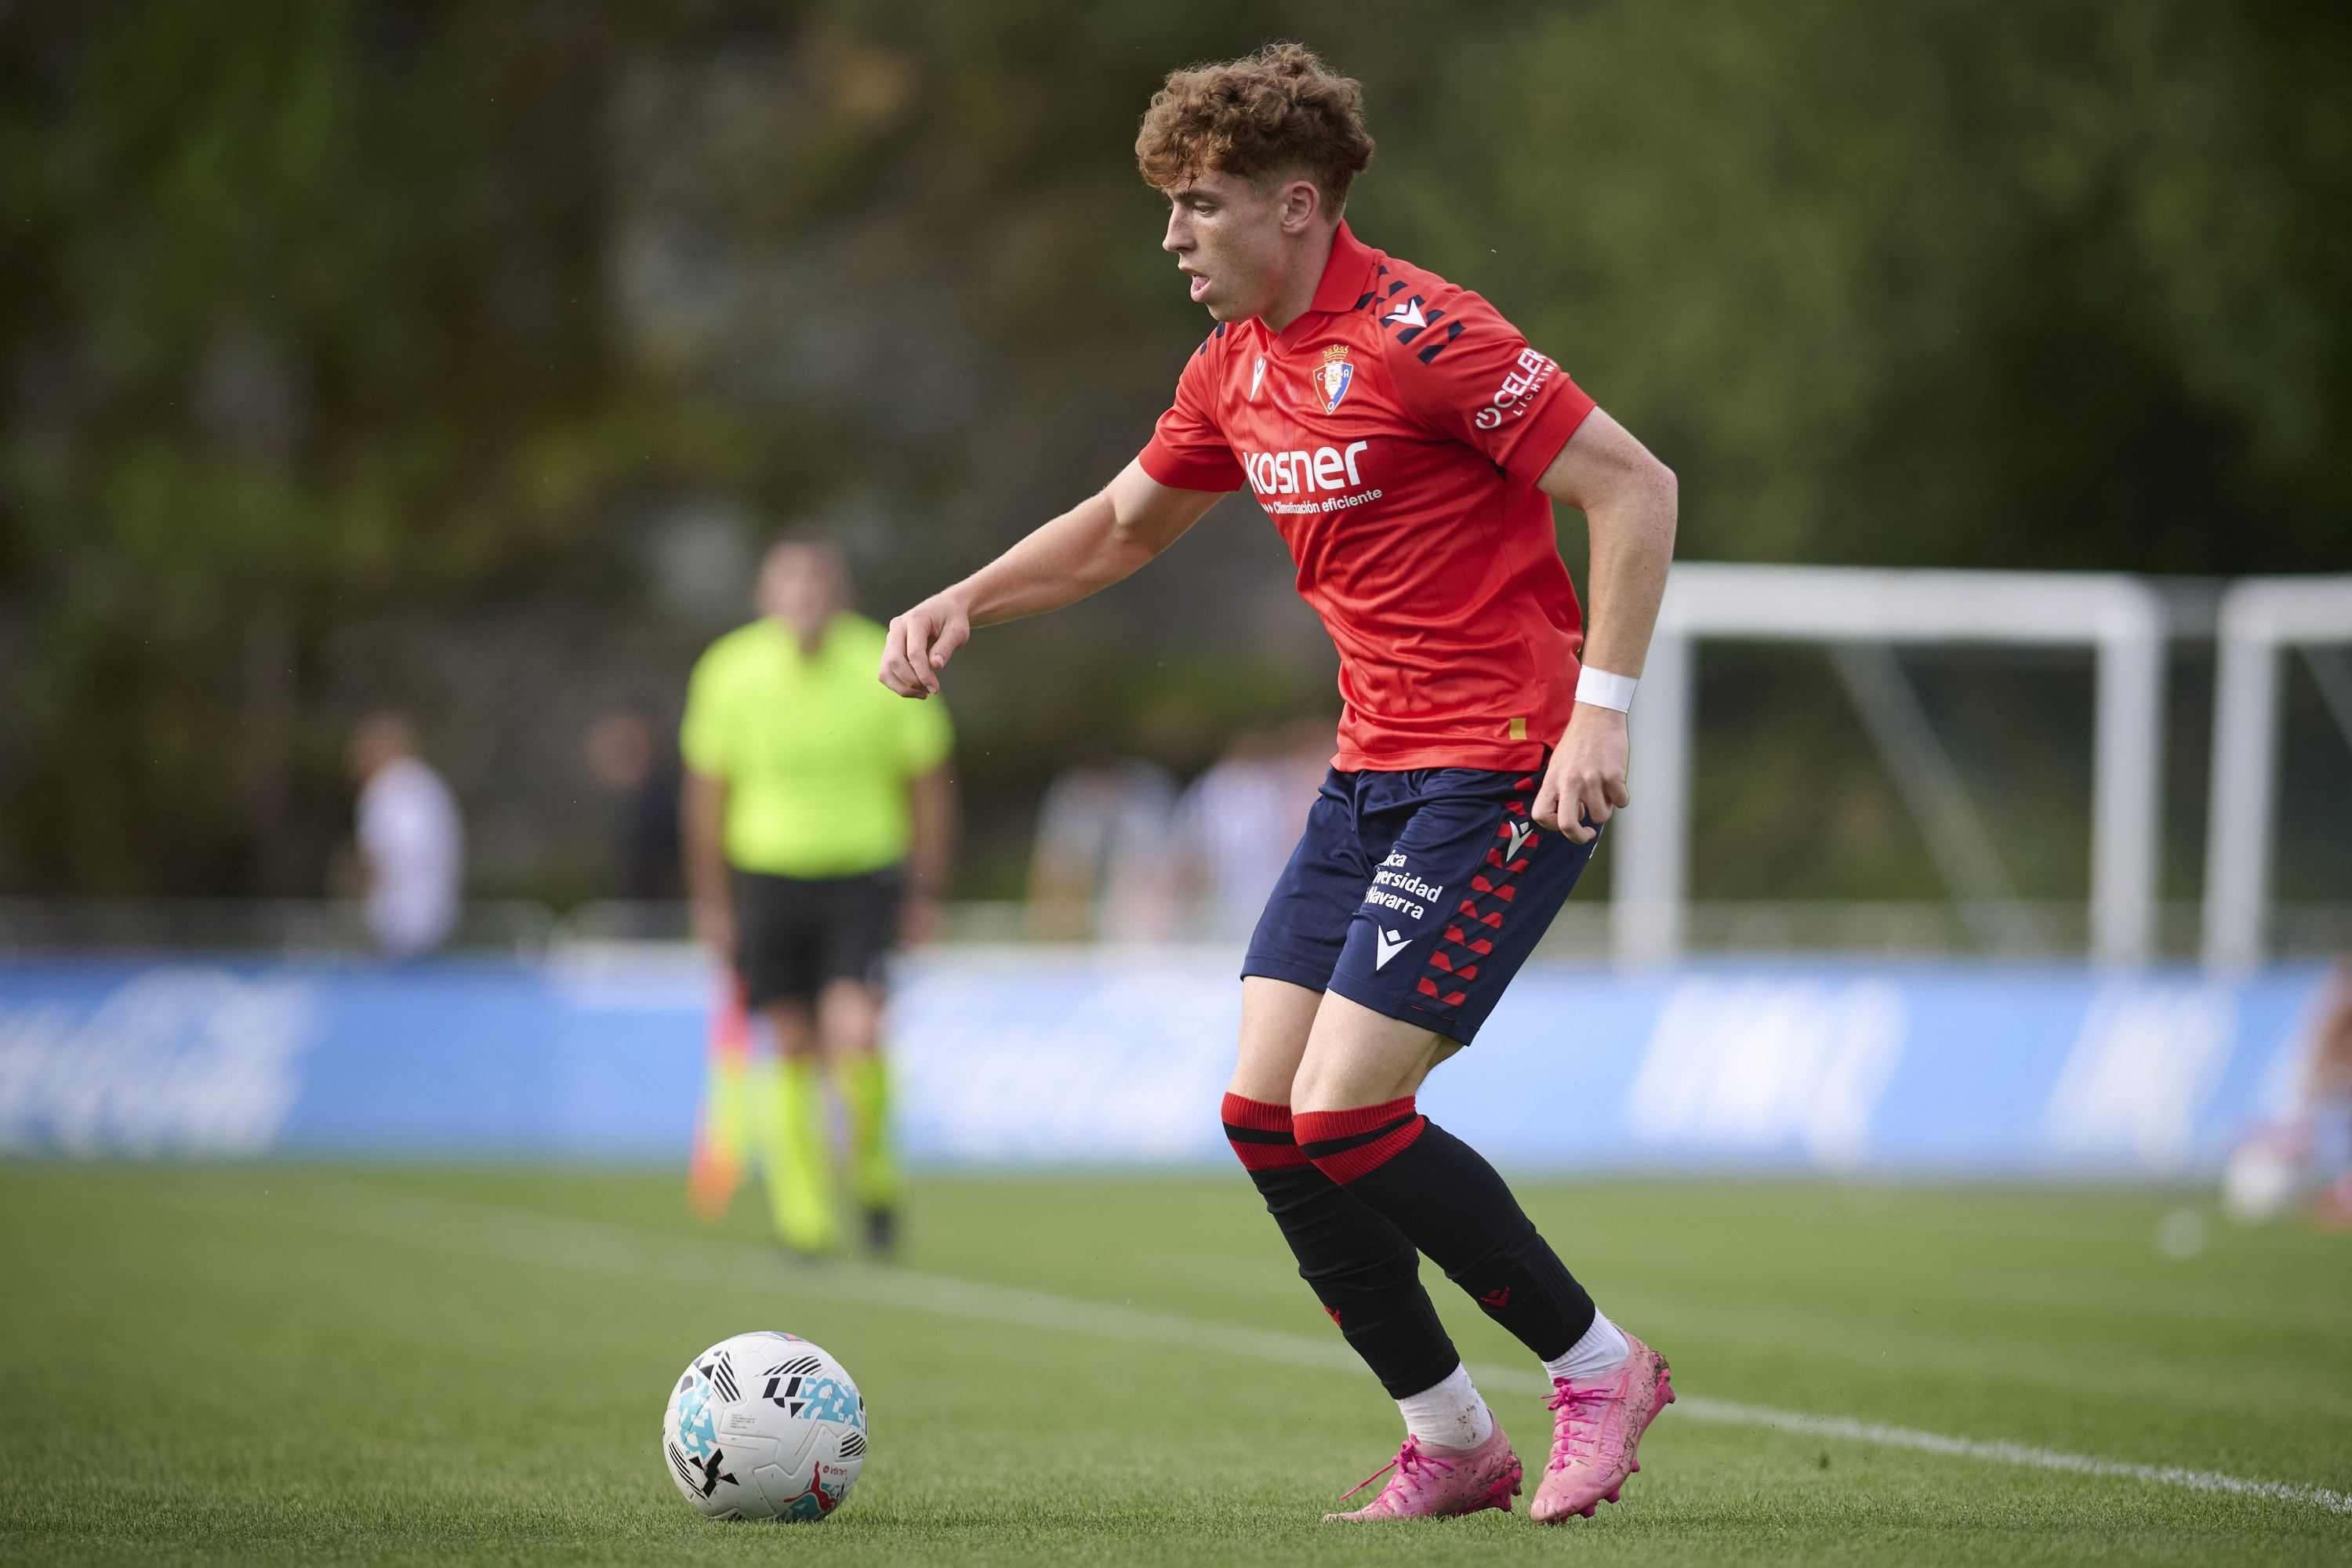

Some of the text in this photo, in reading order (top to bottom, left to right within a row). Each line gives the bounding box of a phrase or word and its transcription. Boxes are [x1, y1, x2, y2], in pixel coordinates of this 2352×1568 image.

[1512, 360, 1559, 416] LIGHTIN
[1243, 441, 1367, 495] kosner
[1322, 488, 1382, 512] eficiente
